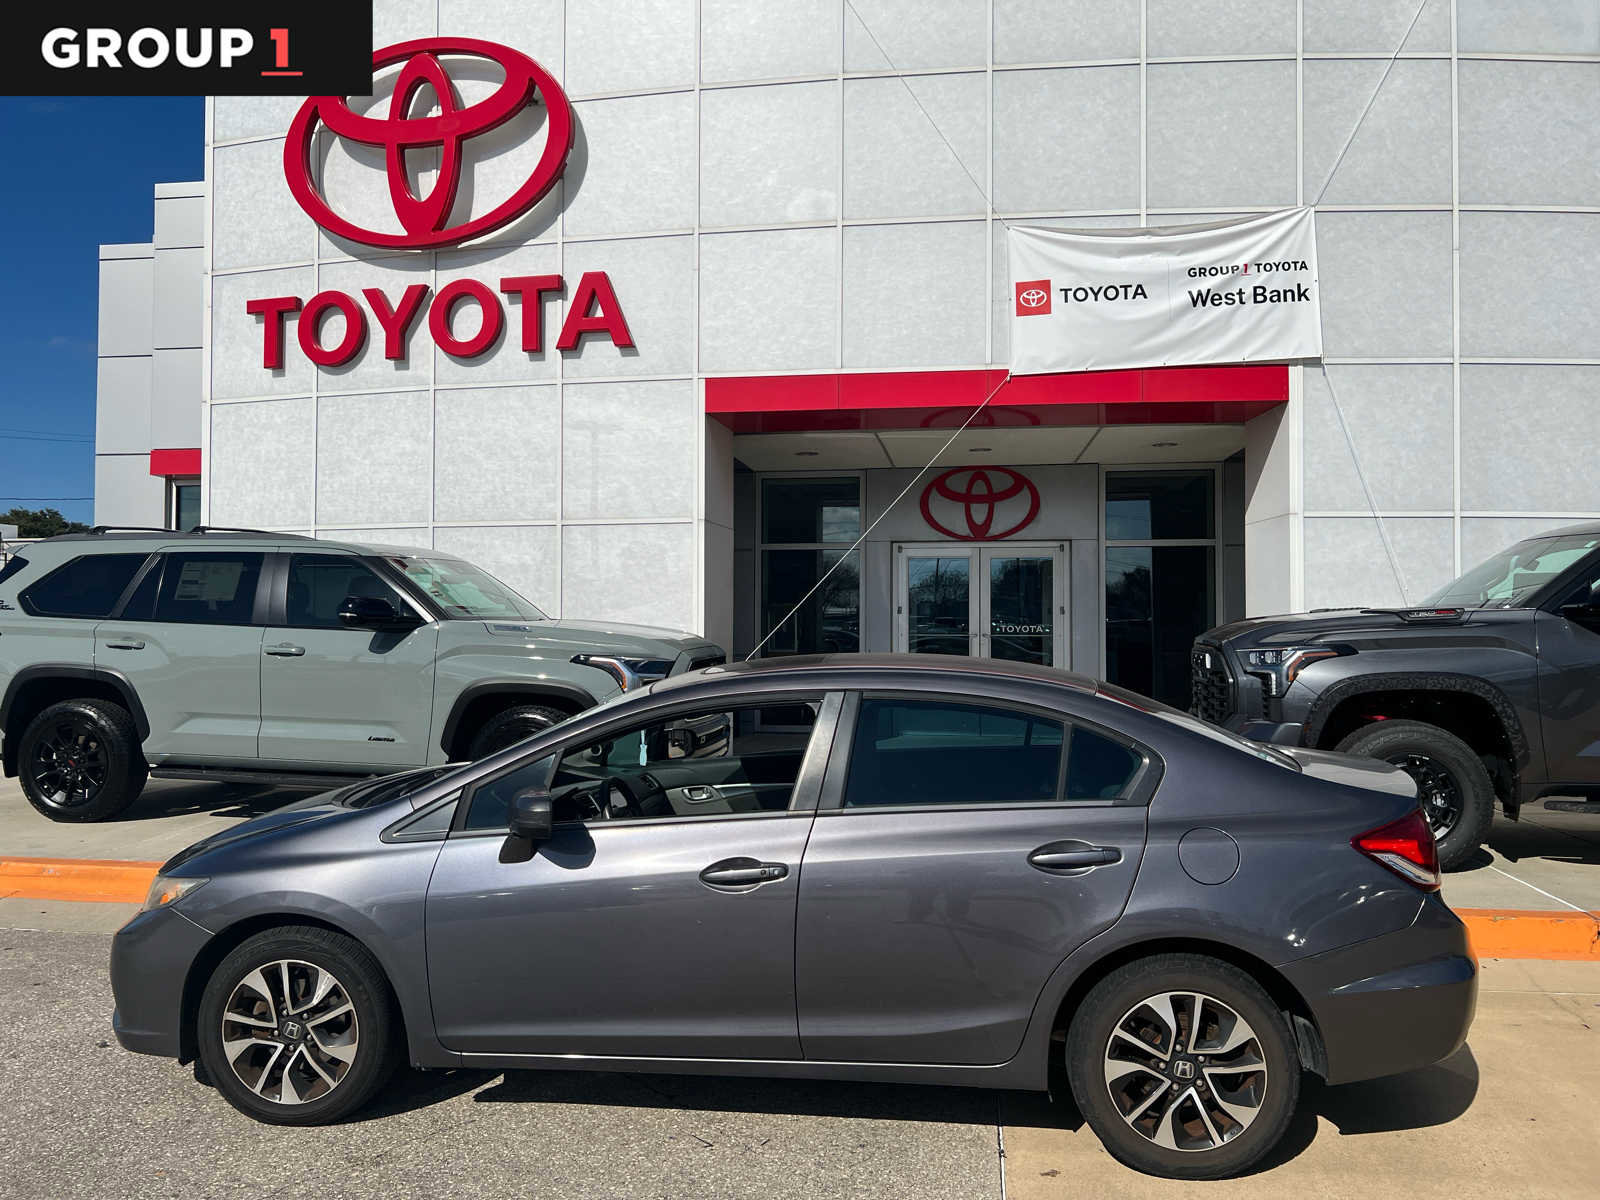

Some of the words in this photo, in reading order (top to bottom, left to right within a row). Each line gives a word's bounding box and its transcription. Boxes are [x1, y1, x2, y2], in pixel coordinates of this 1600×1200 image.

[1187, 265, 1240, 277] GROUP
[1254, 260, 1308, 273] TOYOTA
[1060, 284, 1148, 303] TOYOTA
[1187, 287, 1246, 308] West
[1252, 282, 1310, 305] Bank
[246, 271, 637, 369] TOYOTA
